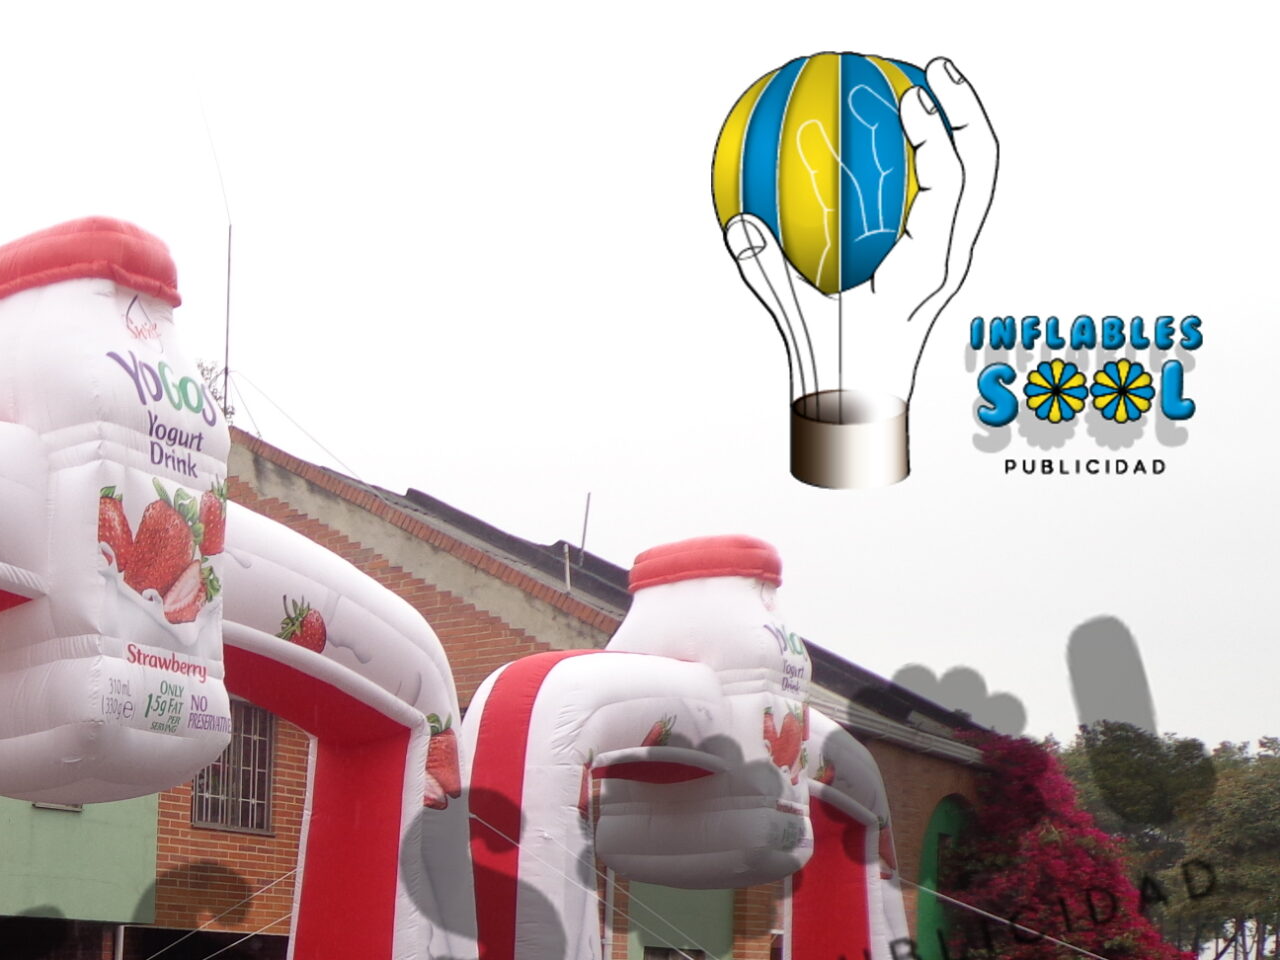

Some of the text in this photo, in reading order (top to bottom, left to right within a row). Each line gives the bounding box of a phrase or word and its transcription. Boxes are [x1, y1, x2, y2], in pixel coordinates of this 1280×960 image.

[147, 410, 204, 452] Yogurt
[150, 441, 198, 479] Drink
[126, 643, 208, 684] Strawberry
[160, 680, 185, 698] ONLY
[167, 698, 185, 715] FAT
[190, 694, 208, 713] NO
